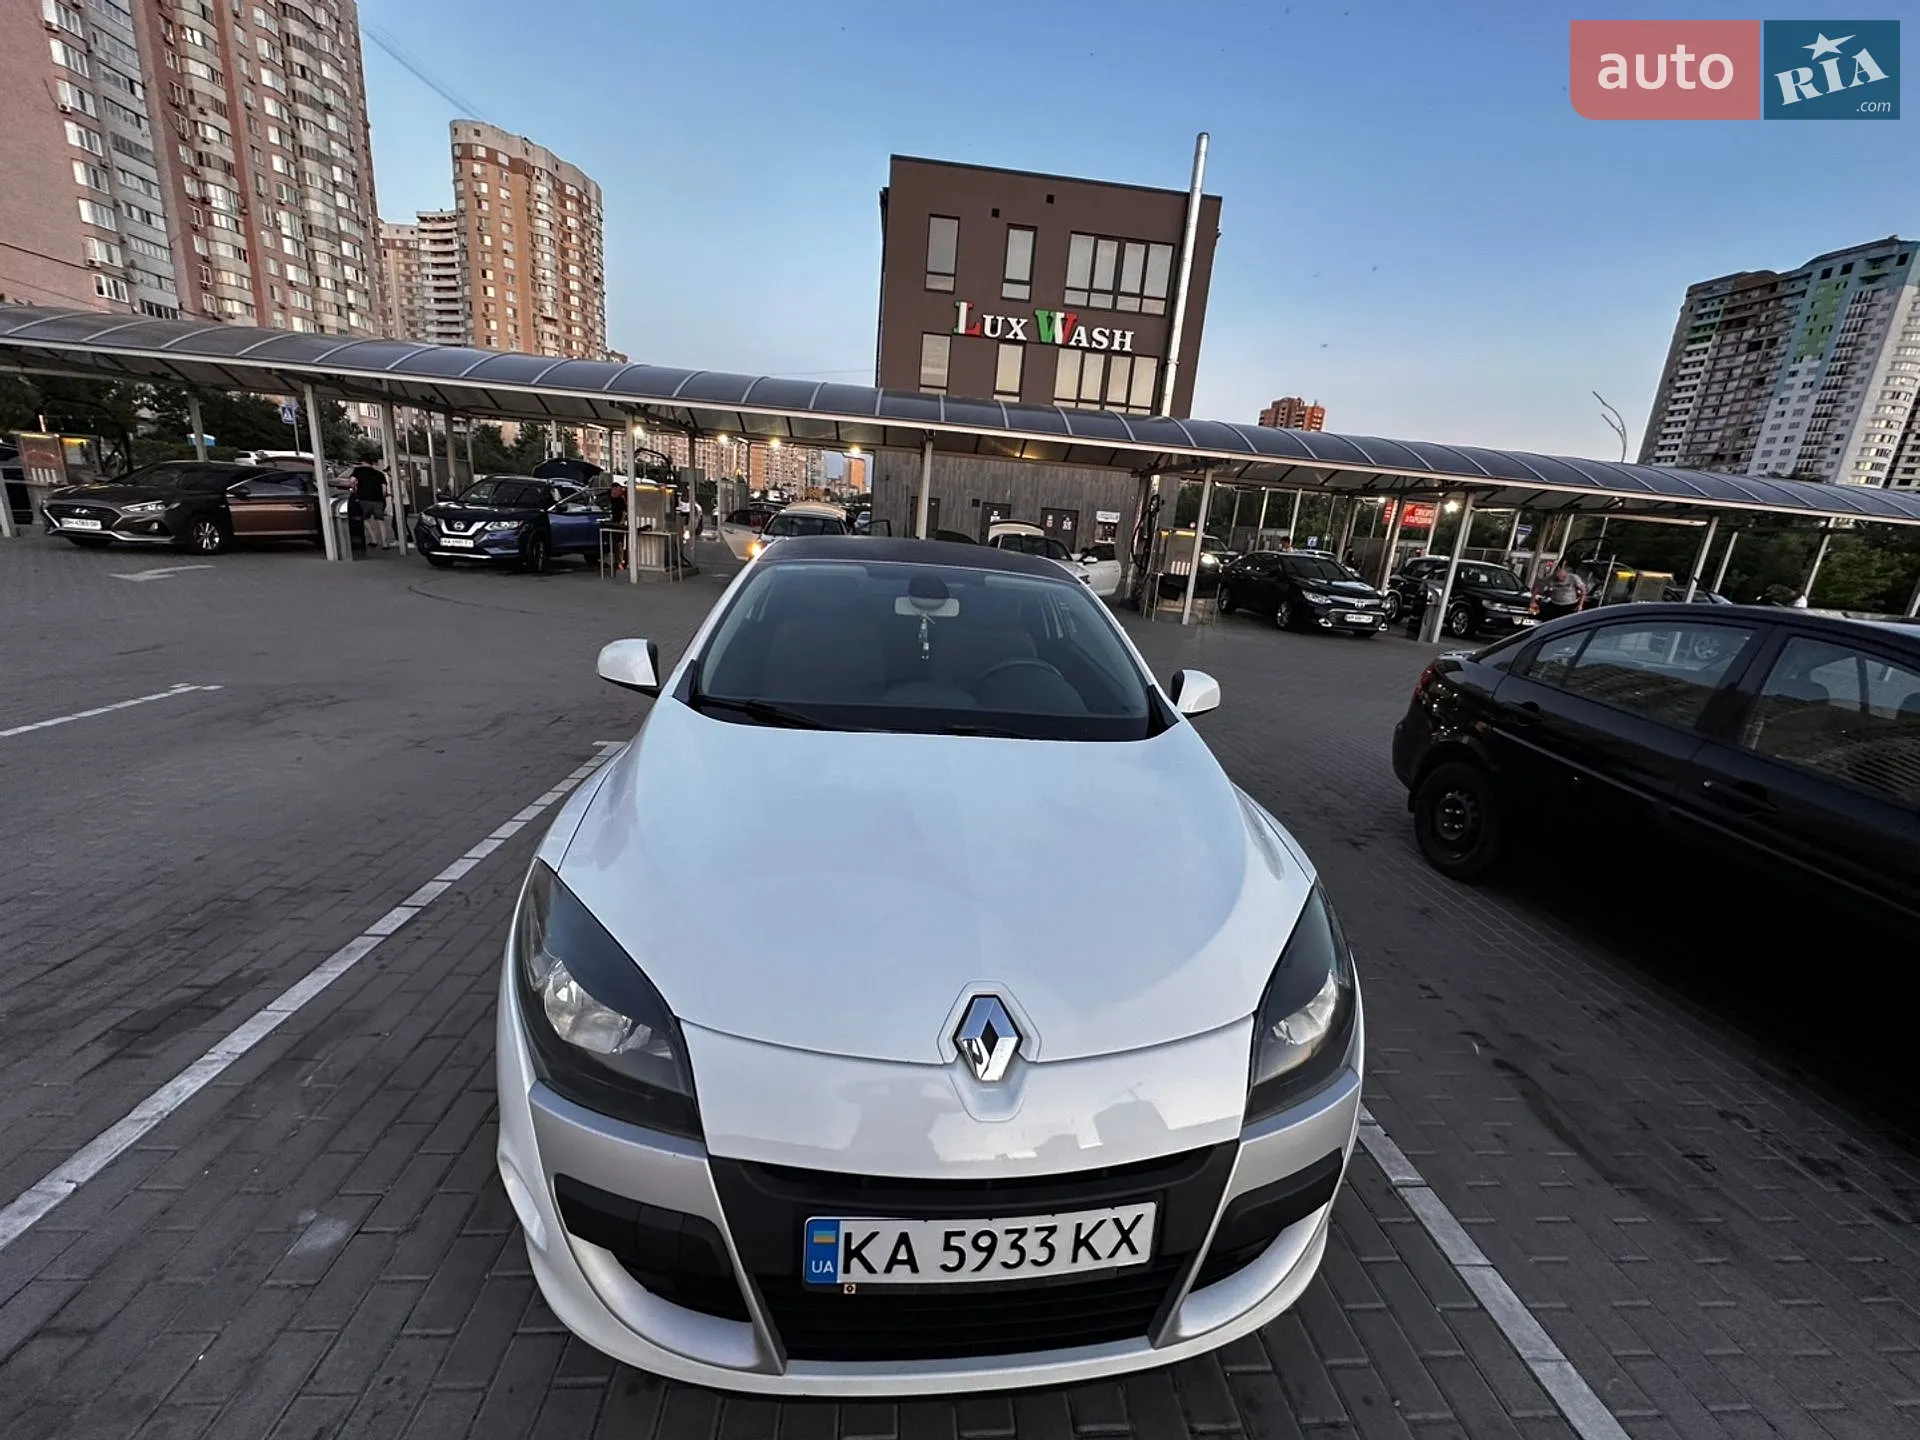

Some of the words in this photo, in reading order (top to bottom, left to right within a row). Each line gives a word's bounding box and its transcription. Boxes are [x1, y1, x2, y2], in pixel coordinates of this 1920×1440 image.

[953, 300, 1028, 341] LUX
[1034, 308, 1135, 352] WASH
[811, 1259, 836, 1274] UA
[842, 1230, 920, 1275] KA
[938, 1224, 1058, 1273] 5933
[1070, 1213, 1144, 1264] KX
